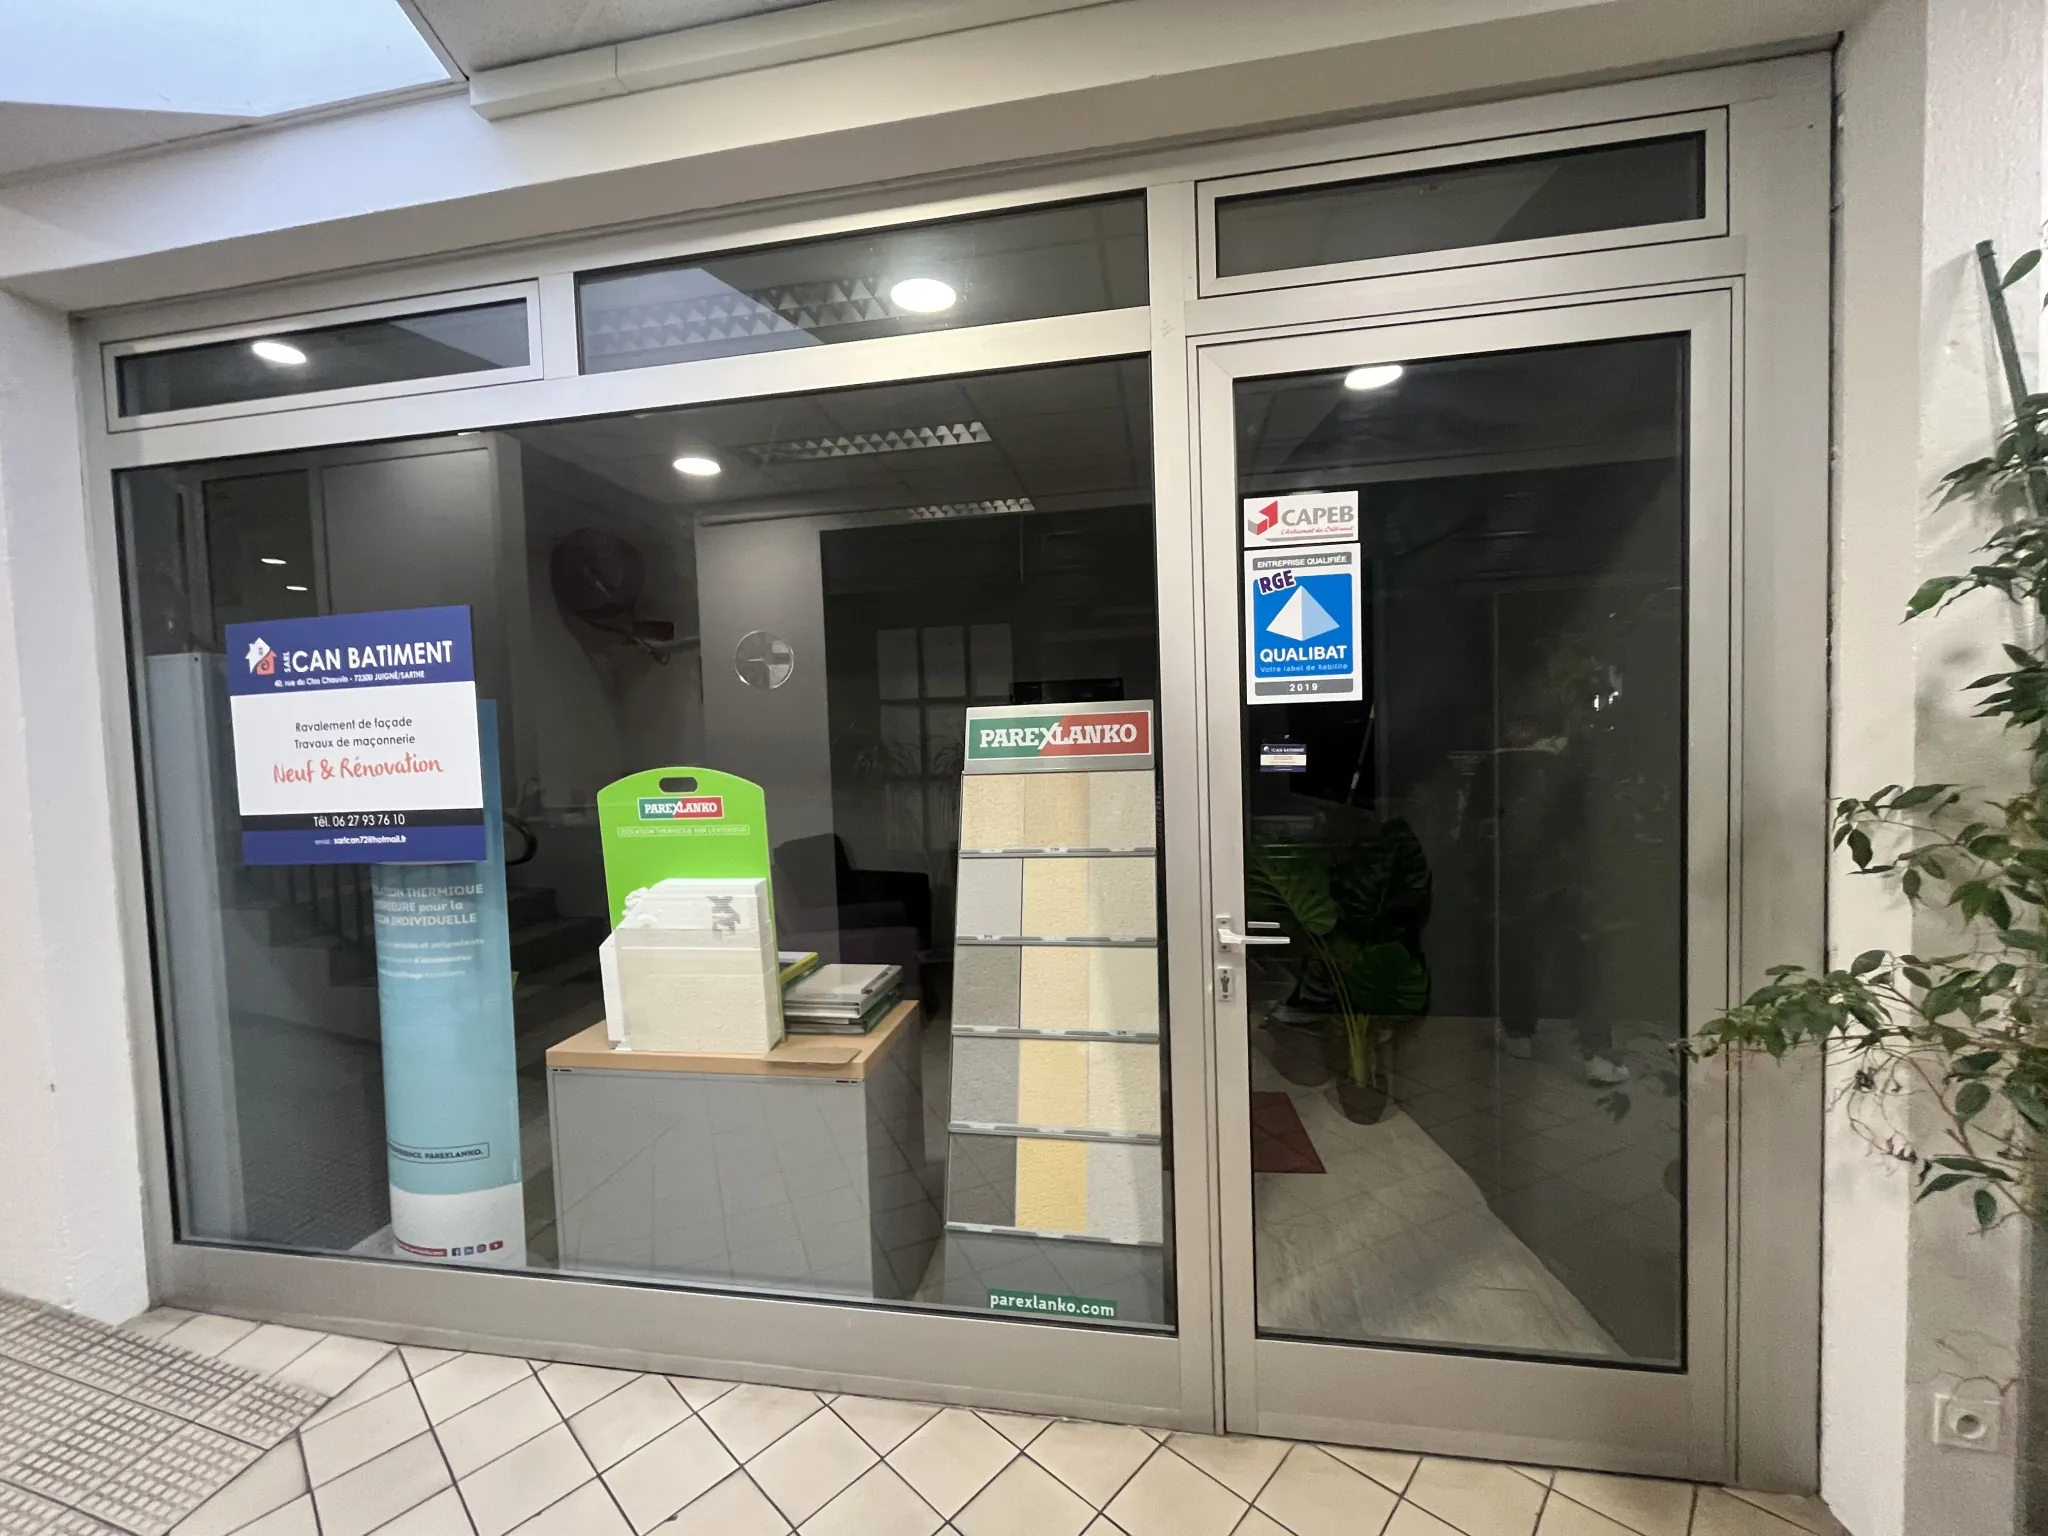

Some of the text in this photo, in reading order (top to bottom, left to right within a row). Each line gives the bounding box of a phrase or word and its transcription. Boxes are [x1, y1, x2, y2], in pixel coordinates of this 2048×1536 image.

[1281, 505, 1354, 527] CAPEB
[1257, 555, 1347, 568] ENTREPRISE QUALIFIÉE
[1259, 569, 1295, 594] RGE
[283, 650, 292, 673] SARL
[292, 640, 453, 673] CAN BATIMENT
[1259, 645, 1348, 663] QUALIBAT
[1260, 665, 1282, 673] Votre
[1284, 664, 1304, 672] label
[306, 677, 321, 685] Clos
[1289, 683, 1318, 692] 2019
[295, 716, 413, 733] Ravalement de façade
[294, 733, 416, 750] Travaux de maçonnerie
[979, 722, 1138, 750] PAREXLANKO
[273, 751, 444, 784] Neuf & Rénovation
[644, 801, 718, 816] PAREXLANKO
[313, 813, 406, 828] Tél. 06 27 93 76 10
[407, 884, 484, 898] THERMIQUE
[419, 904, 448, 914] pour
[450, 900, 464, 910] la
[989, 1294, 1115, 1317] parexlanko.com
